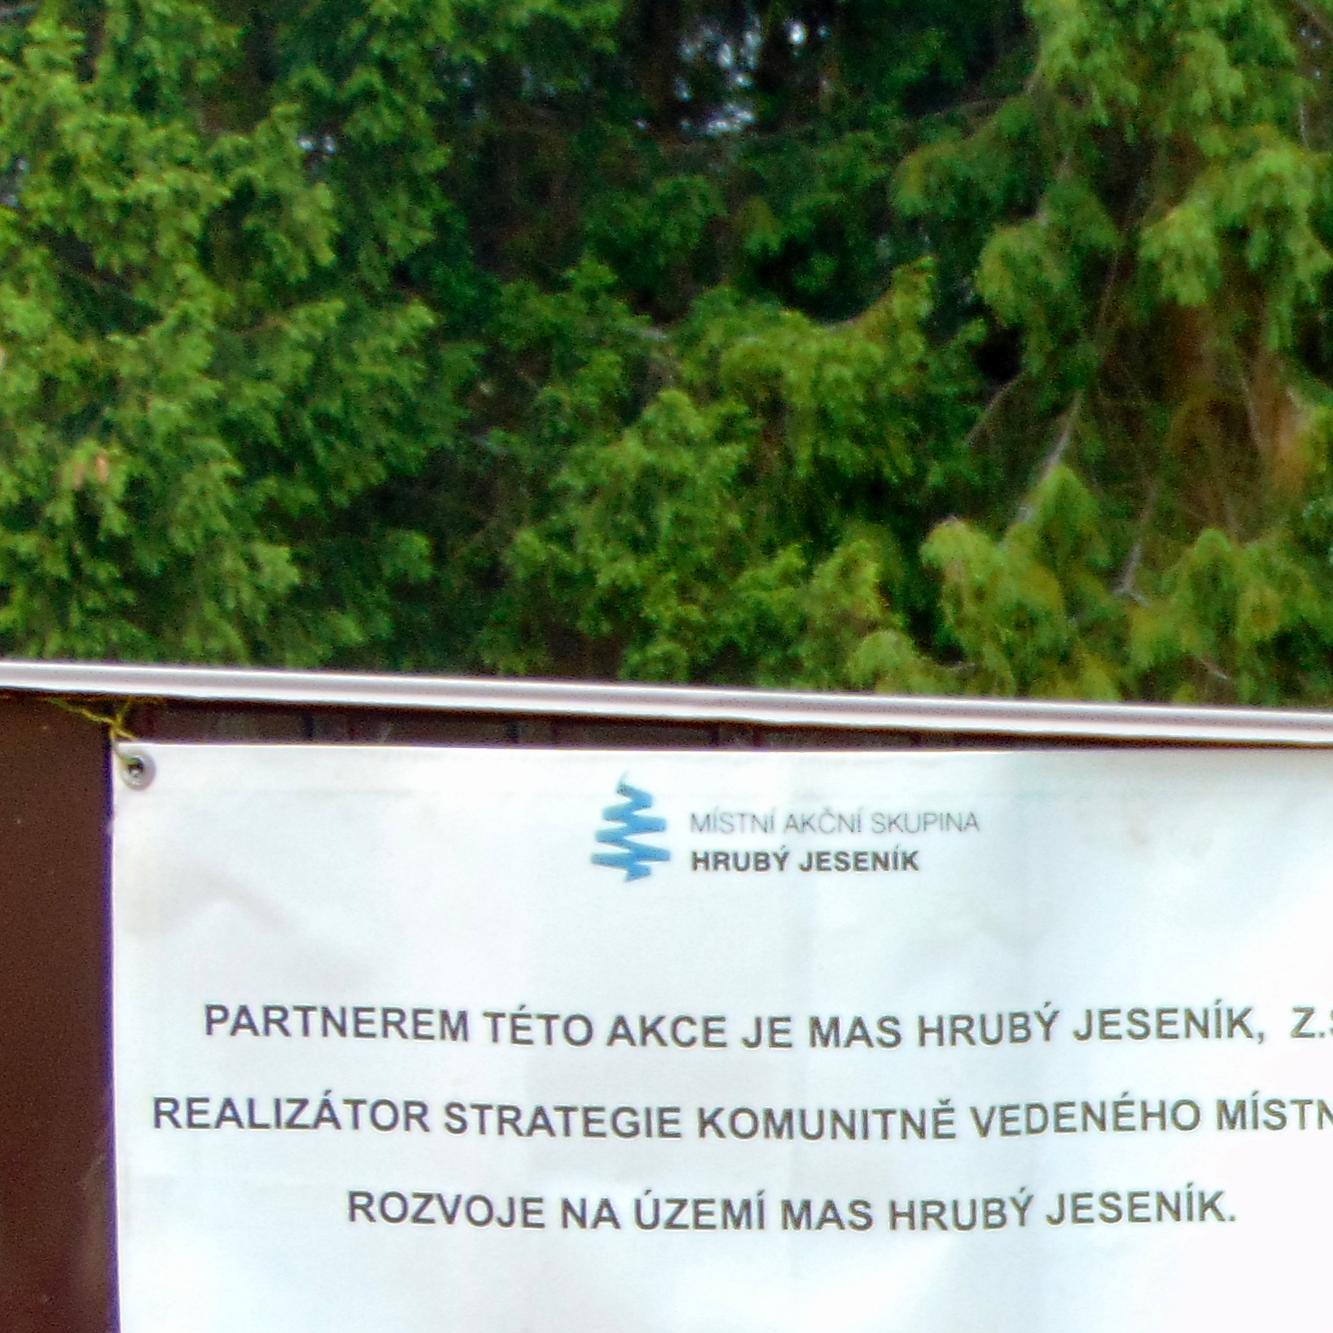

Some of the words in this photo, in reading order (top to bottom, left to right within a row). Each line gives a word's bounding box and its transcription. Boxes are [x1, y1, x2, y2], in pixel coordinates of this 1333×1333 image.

[690, 808, 775, 834] MÍSTNÍ
[783, 808, 863, 834] AKČNÍ
[871, 811, 981, 834] SKUPINA
[692, 845, 789, 872] HRUBÝ
[800, 847, 920, 872] JESENÍK
[204, 1003, 470, 1043] PARTNEREM
[484, 1006, 595, 1047] TÉTO
[606, 1014, 728, 1048] AKCE
[742, 1016, 793, 1048] JE
[809, 1014, 902, 1048] MAS
[918, 1001, 1060, 1047] HRUBÝ
[1073, 1000, 1266, 1045] JESENÍK,
[153, 1089, 430, 1132] REALIZÁTOR
[444, 1102, 682, 1139] STRATEGIE
[698, 1099, 956, 1141] KOMUNITNĚ
[971, 1091, 1201, 1138] VEDENÉHO
[348, 1190, 545, 1229] ROZVOJE
[561, 1197, 621, 1230] NA
[634, 1189, 766, 1231] ÚZEMÍ
[781, 1199, 874, 1232] MAS
[890, 1187, 1034, 1232] HRUBÝ
[1046, 1183, 1237, 1227] JESENÍK.
